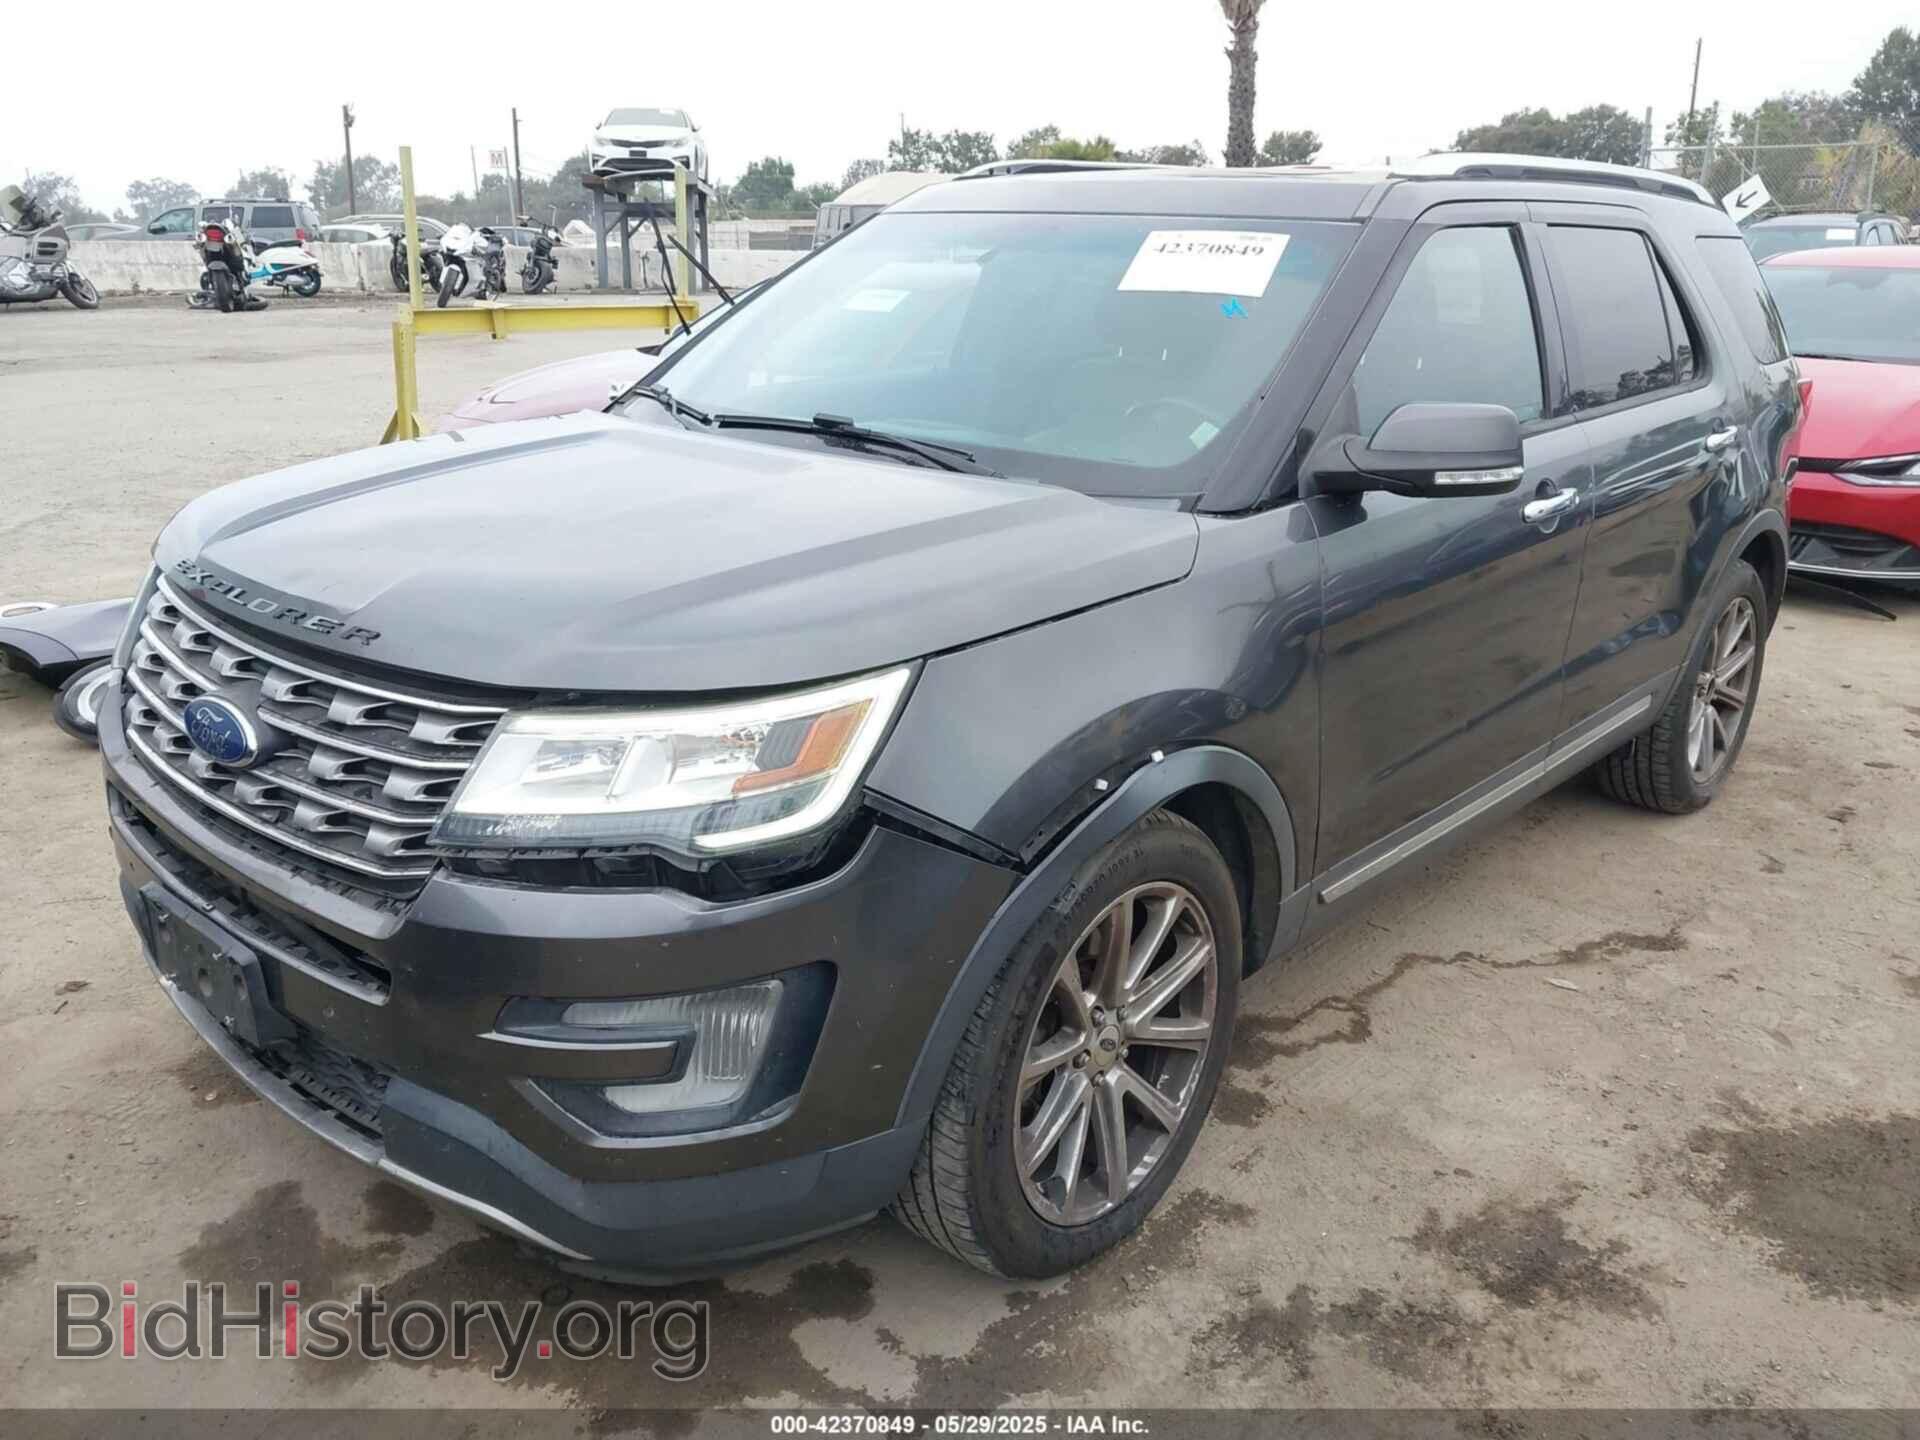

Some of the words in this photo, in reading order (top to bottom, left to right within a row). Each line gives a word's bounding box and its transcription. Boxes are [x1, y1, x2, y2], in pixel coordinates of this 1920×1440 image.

[1153, 242, 1265, 256] 42370849
[175, 558, 382, 647] EXPLORER
[191, 706, 232, 753] Ford
